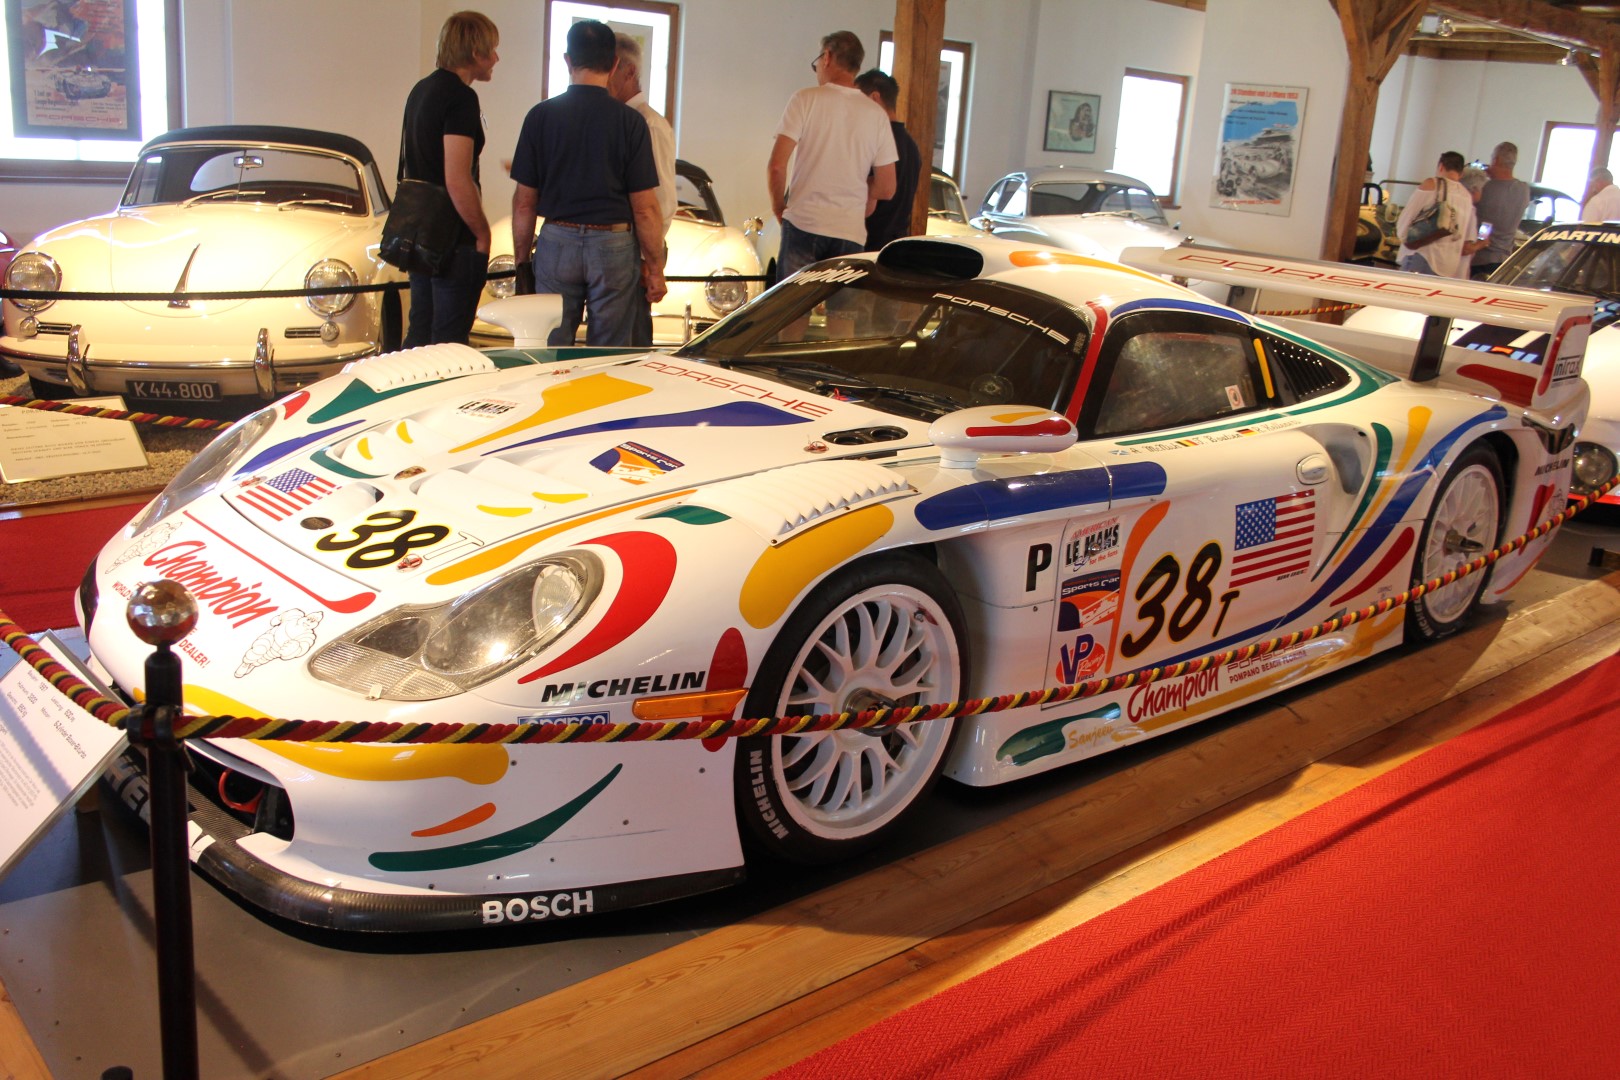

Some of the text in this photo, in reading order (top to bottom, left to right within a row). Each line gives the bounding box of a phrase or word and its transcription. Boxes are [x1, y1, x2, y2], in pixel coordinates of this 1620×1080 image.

[1179, 254, 1549, 313] PORSCHE
[932, 292, 1070, 345] PORSCHE
[133, 382, 148, 397] K
[637, 361, 833, 418] PORSCHE
[620, 443, 658, 461] Sports
[315, 509, 451, 569] 38
[1065, 539, 1080, 566] LE
[1084, 523, 1120, 559] MANS
[143, 540, 279, 629] Champion
[1026, 543, 1053, 592] P
[1062, 581, 1099, 595] Sports
[1101, 576, 1120, 587] Car
[1119, 540, 1240, 660] 38 T
[178, 639, 211, 669] DEALER!
[1060, 634, 1095, 685] VP
[1229, 649, 1307, 684] POMPANO BEACH FLORIDA
[541, 671, 706, 706] MICHELIN
[1127, 666, 1219, 723] Champion
[749, 749, 790, 840] MICHELIN
[482, 889, 594, 925] BOSCH
